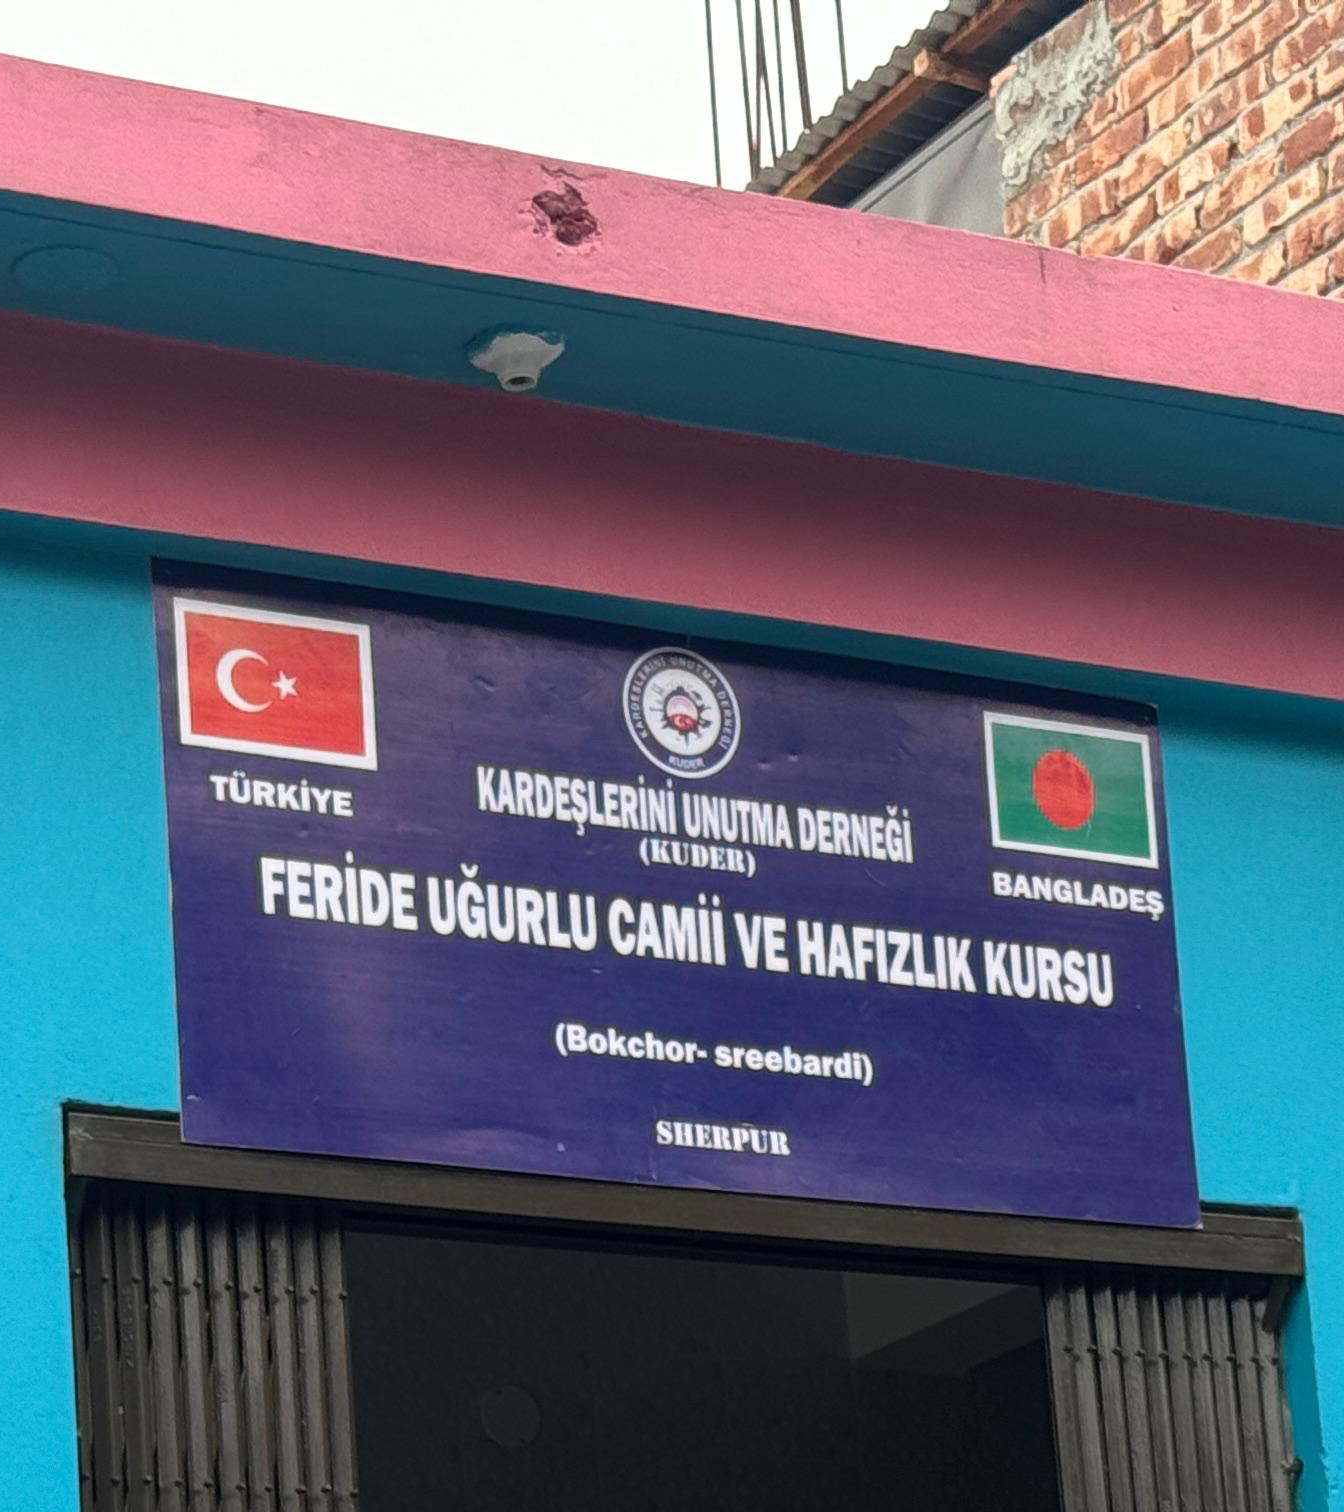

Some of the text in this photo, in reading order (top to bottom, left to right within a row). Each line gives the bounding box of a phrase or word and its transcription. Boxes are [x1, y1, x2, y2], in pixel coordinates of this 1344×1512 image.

[209, 770, 354, 818] TÜRKİYE
[476, 765, 914, 863] KARDEŞLERİNİ UNUTMA DERNEĞİ
[639, 837, 756, 878] (KUDER)
[992, 871, 1165, 921] BANGLADEŞ
[260, 850, 1114, 1007] FERİDE UĞURLU CAMİİ VE HAFIZLIK KURSU
[555, 1022, 873, 1087] (Bokchor- sreebardi)
[656, 1120, 791, 1156] SHERPUR
